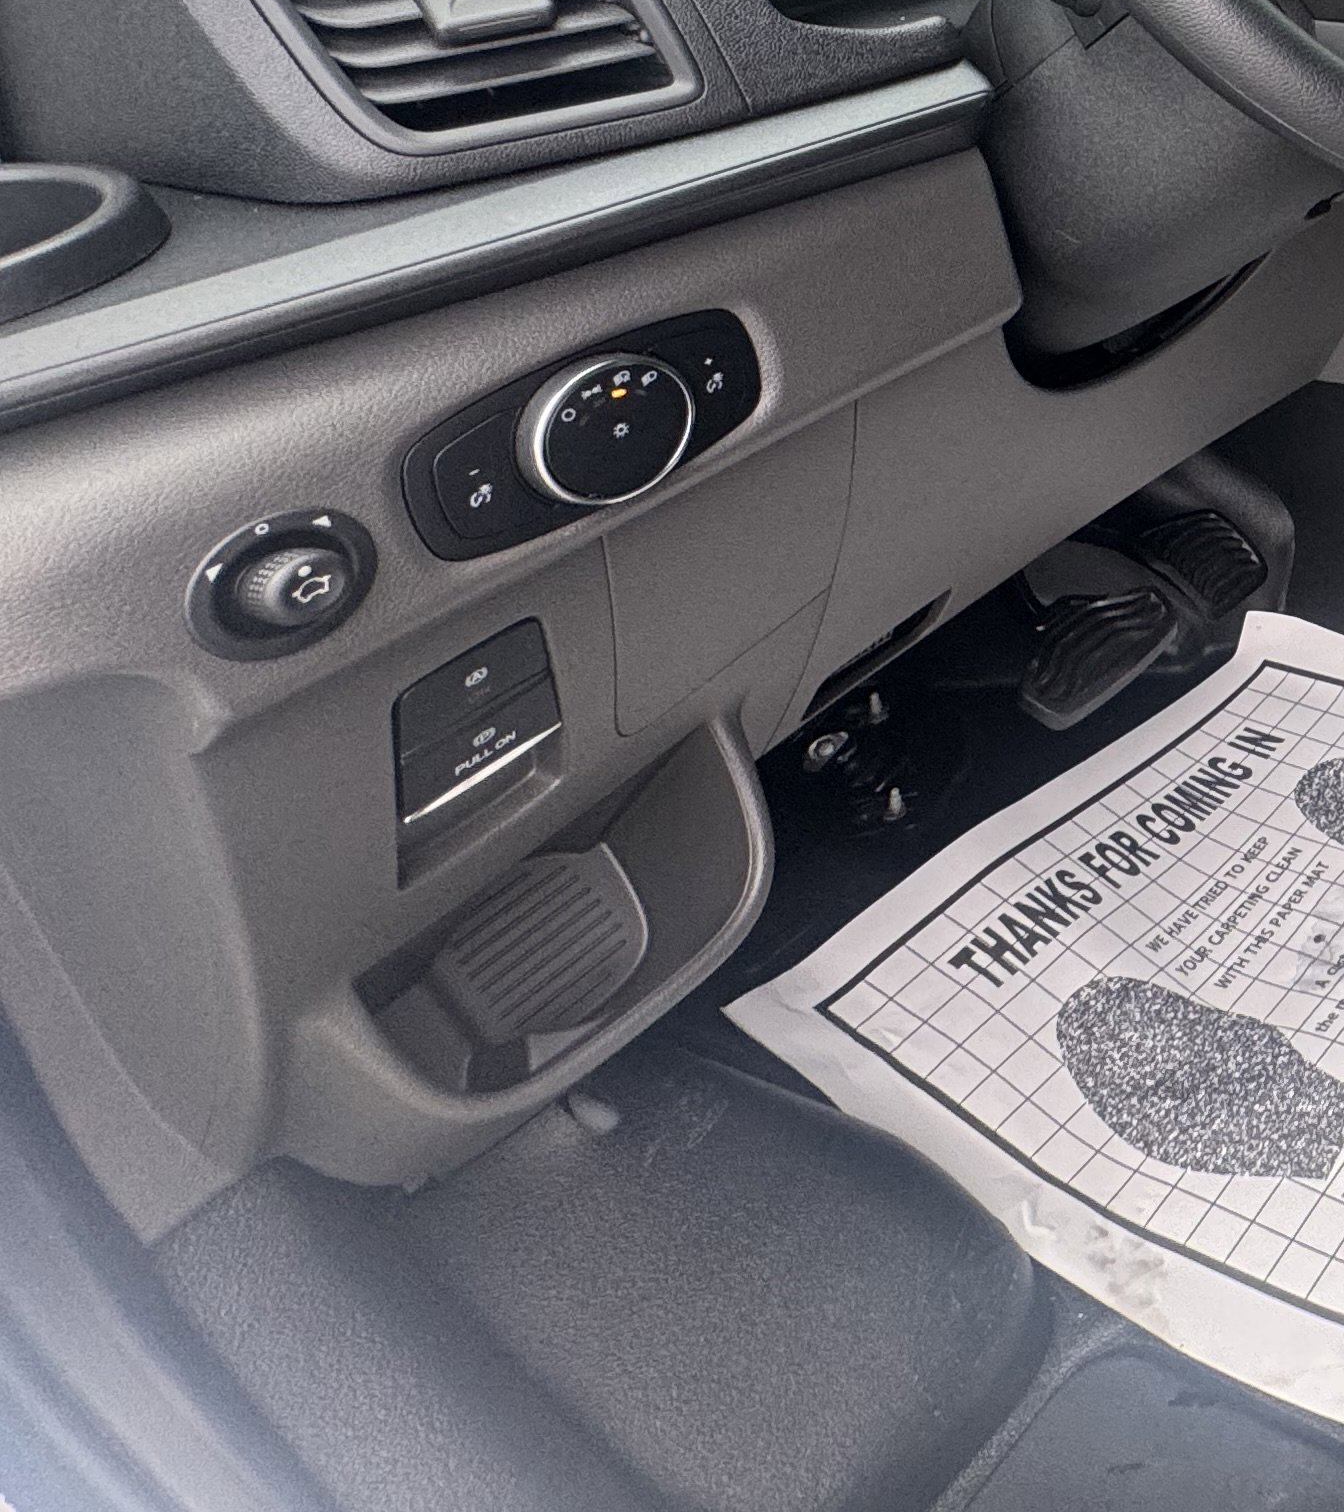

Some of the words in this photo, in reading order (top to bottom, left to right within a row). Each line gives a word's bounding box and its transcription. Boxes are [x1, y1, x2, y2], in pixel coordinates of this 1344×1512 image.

[455, 749, 494, 776] PULL
[495, 731, 516, 750] ON
[948, 870, 1103, 988] THANKS
[1078, 830, 1161, 889] FOR
[1136, 756, 1253, 845] COMING
[1227, 727, 1286, 760] IN
[1145, 934, 1169, 953] WE
[1166, 909, 1199, 938] HAVE
[1192, 880, 1229, 911] TRIED
[1224, 864, 1245, 880] TO
[1241, 836, 1269, 863] KEEP
[1175, 945, 1213, 977] YOUR
[1208, 884, 1270, 946] CARPETING
[1265, 846, 1303, 883] CLEAN
[1214, 956, 1250, 989] WITH
[1243, 928, 1275, 955] THIS
[1269, 889, 1308, 928] PAPER
[1302, 861, 1329, 888] MAT
[1315, 979, 1331, 989] A
[1315, 1012, 1339, 1032] the
